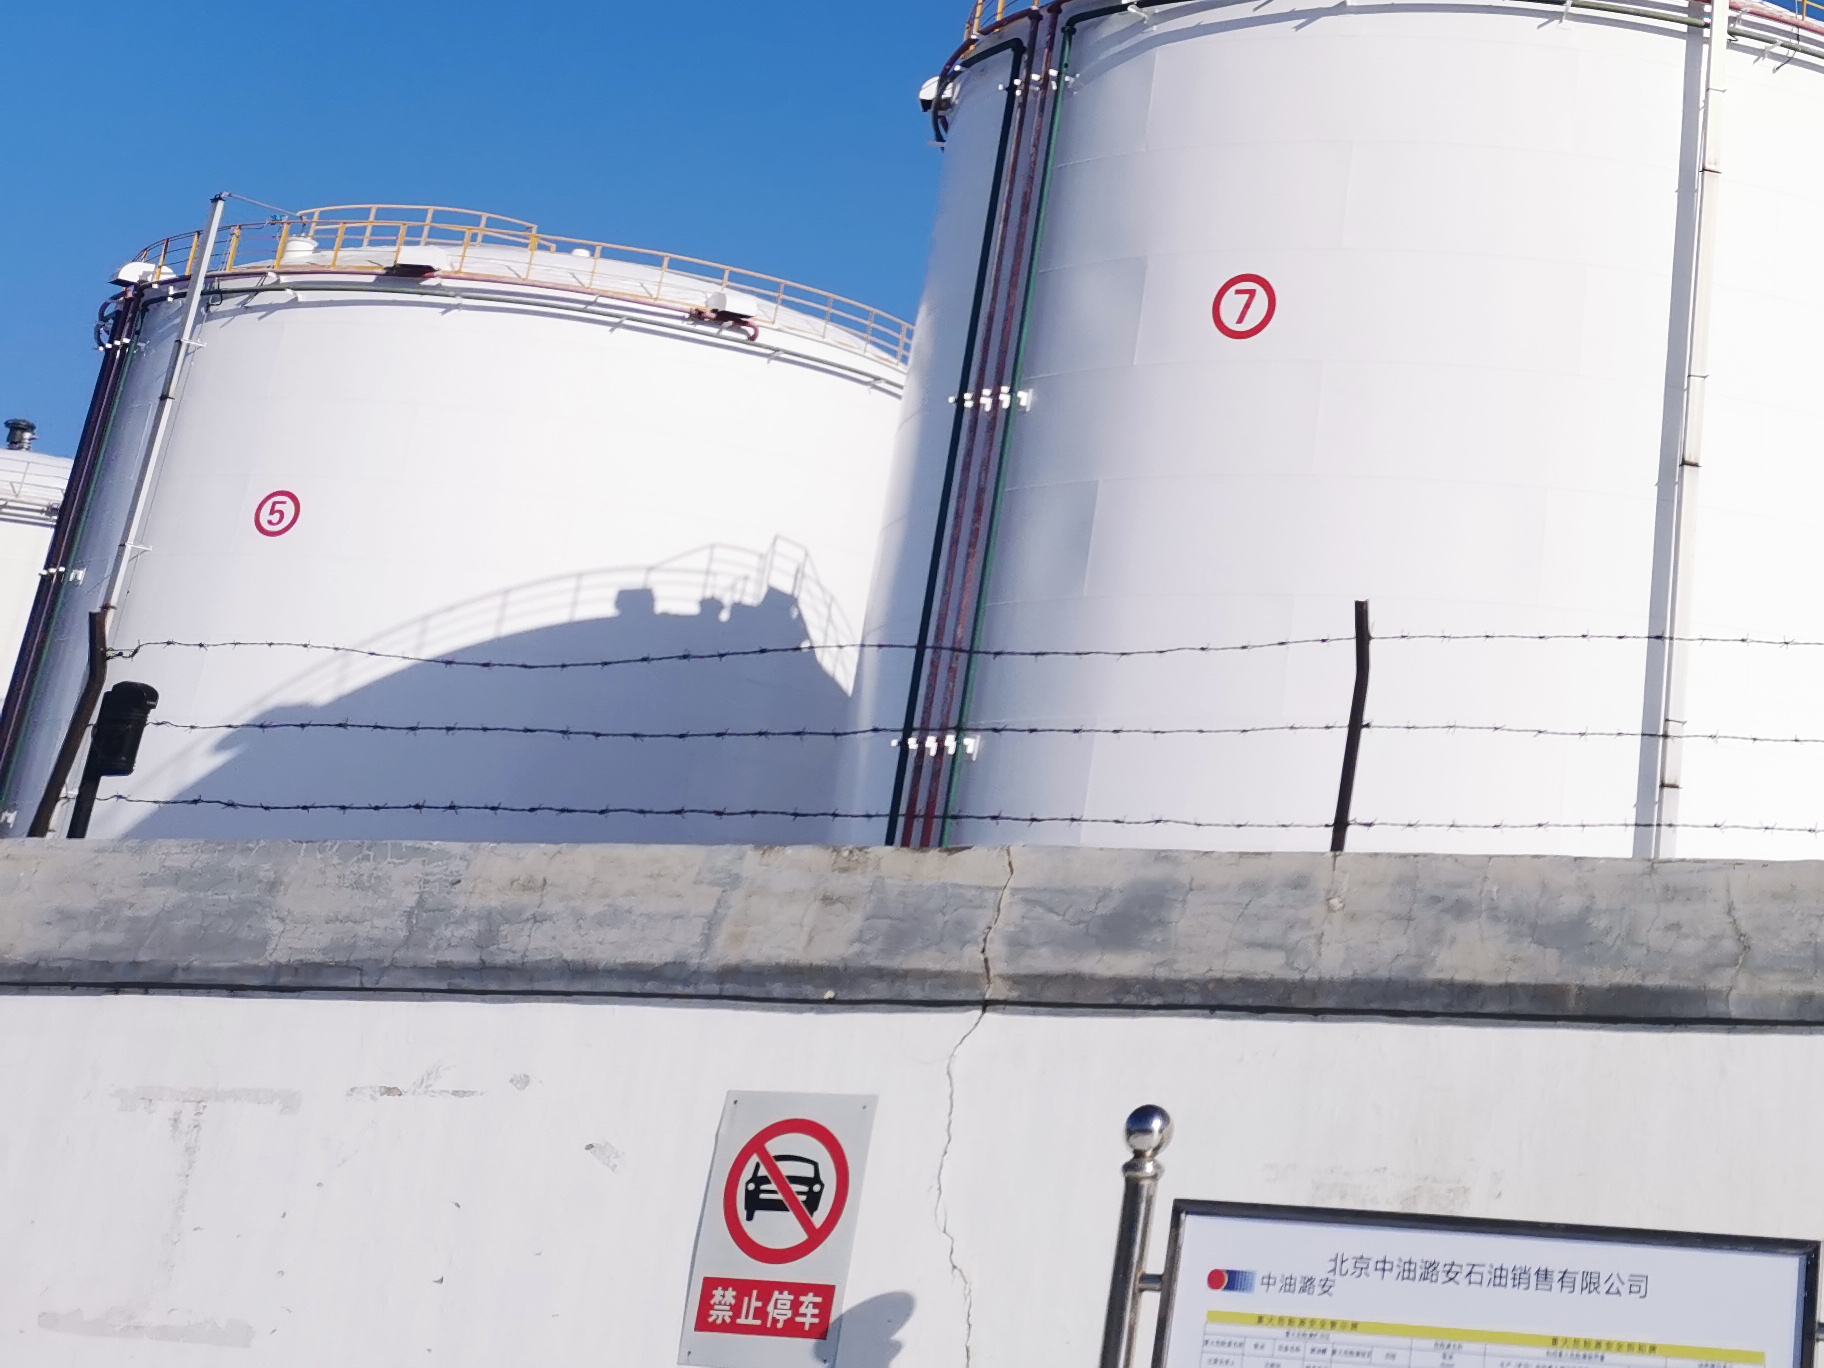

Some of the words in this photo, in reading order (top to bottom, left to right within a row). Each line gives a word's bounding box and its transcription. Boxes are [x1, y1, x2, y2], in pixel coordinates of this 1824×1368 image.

[1234, 288, 1257, 325] 7
[266, 500, 287, 526] 5
[1260, 1271, 1336, 1297] 中油潞安
[1328, 1251, 1649, 1299] 北京中油潞安石油销售有限公司
[707, 1286, 823, 1331] 禁止停车
